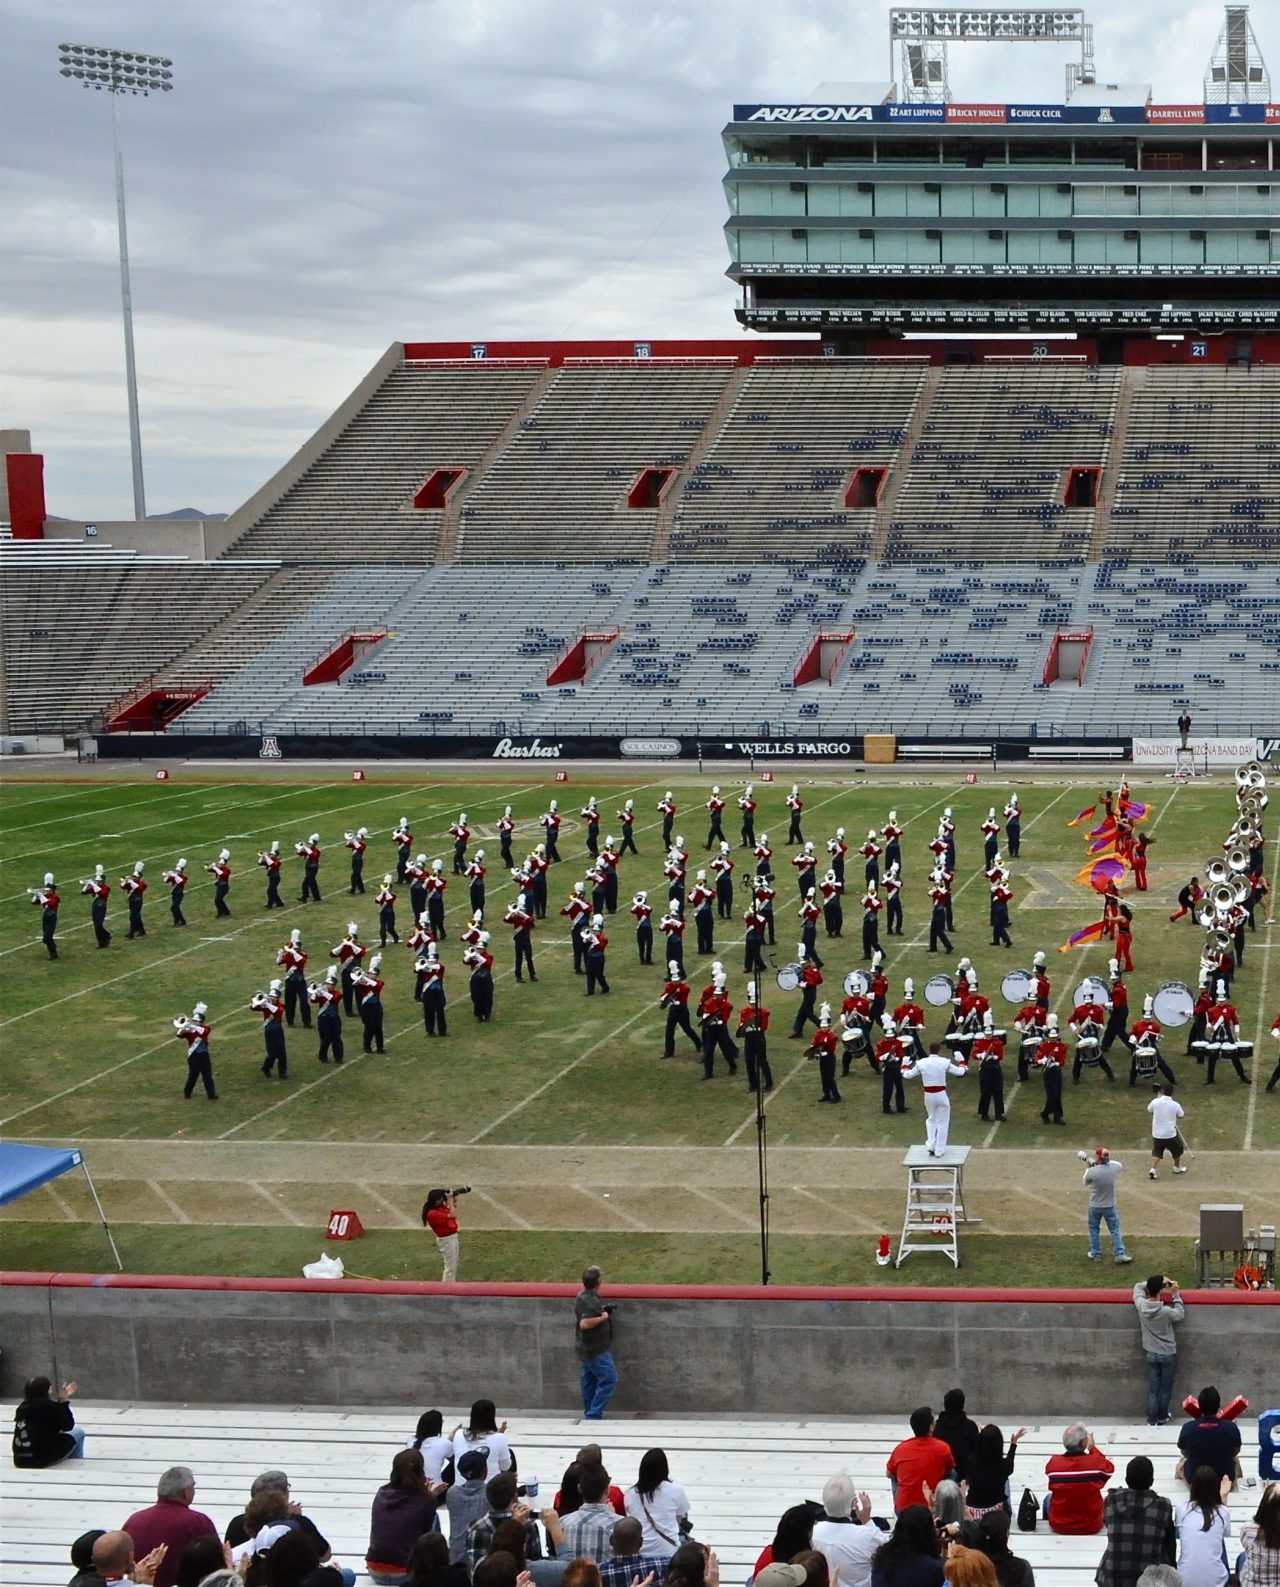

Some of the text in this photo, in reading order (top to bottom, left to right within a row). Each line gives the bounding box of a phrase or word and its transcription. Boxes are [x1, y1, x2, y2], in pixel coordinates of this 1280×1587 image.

[747, 107, 873, 121] ARIZONA
[890, 108, 943, 116] 22 ART LUPPINO
[1017, 109, 1041, 117] CHUCK
[1042, 109, 1061, 117] CECIL
[473, 350, 484, 358] 17
[636, 348, 648, 357] 18
[824, 348, 834, 356] 19
[1033, 346, 1047, 356] 20
[1193, 346, 1204, 356] 21
[86, 526, 97, 535] 16
[260, 736, 281, 758] A
[492, 738, 563, 757] Bashas'
[738, 743, 850, 754] WELLS FARGO
[1136, 745, 1172, 756] UNIVERSITY
[1218, 746, 1237, 757] BAND
[1239, 746, 1253, 757] DAY
[329, 1214, 349, 1236] 40
